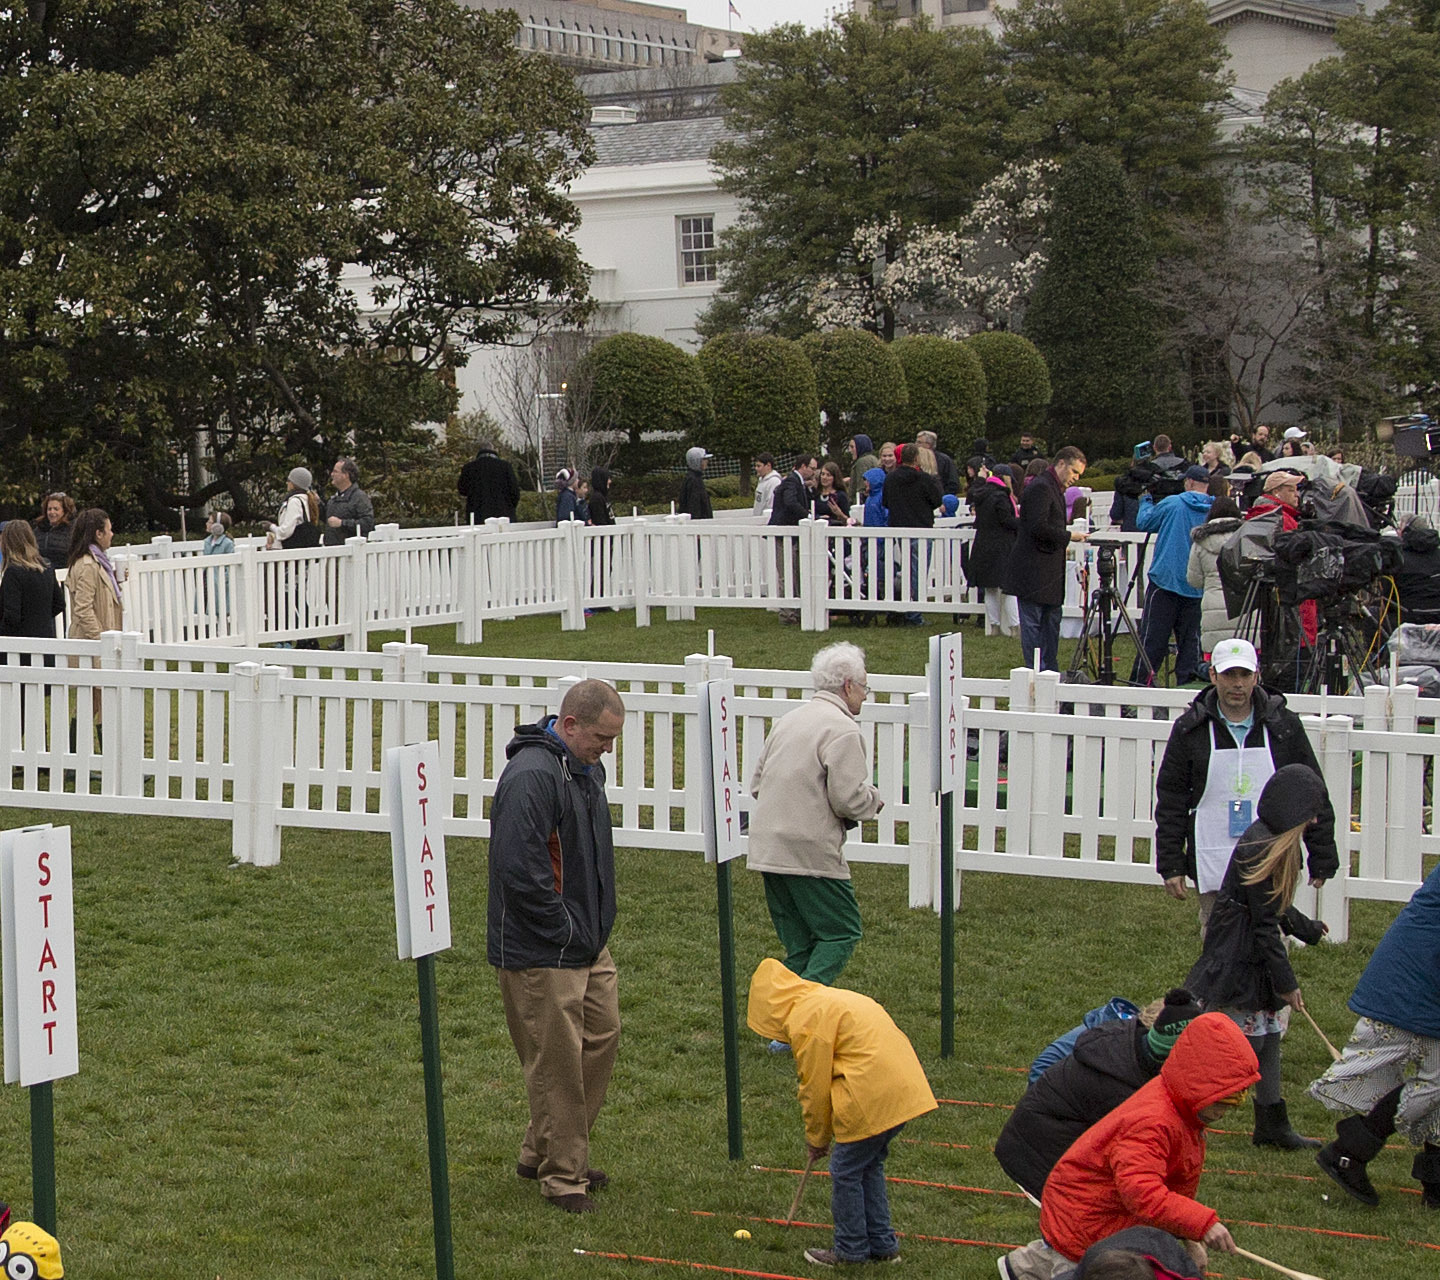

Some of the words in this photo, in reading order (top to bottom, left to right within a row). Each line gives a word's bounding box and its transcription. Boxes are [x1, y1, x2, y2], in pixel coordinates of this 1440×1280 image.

[721, 696, 734, 842] START
[948, 650, 957, 776] START
[416, 762, 436, 933] START
[37, 851, 58, 1056] START
